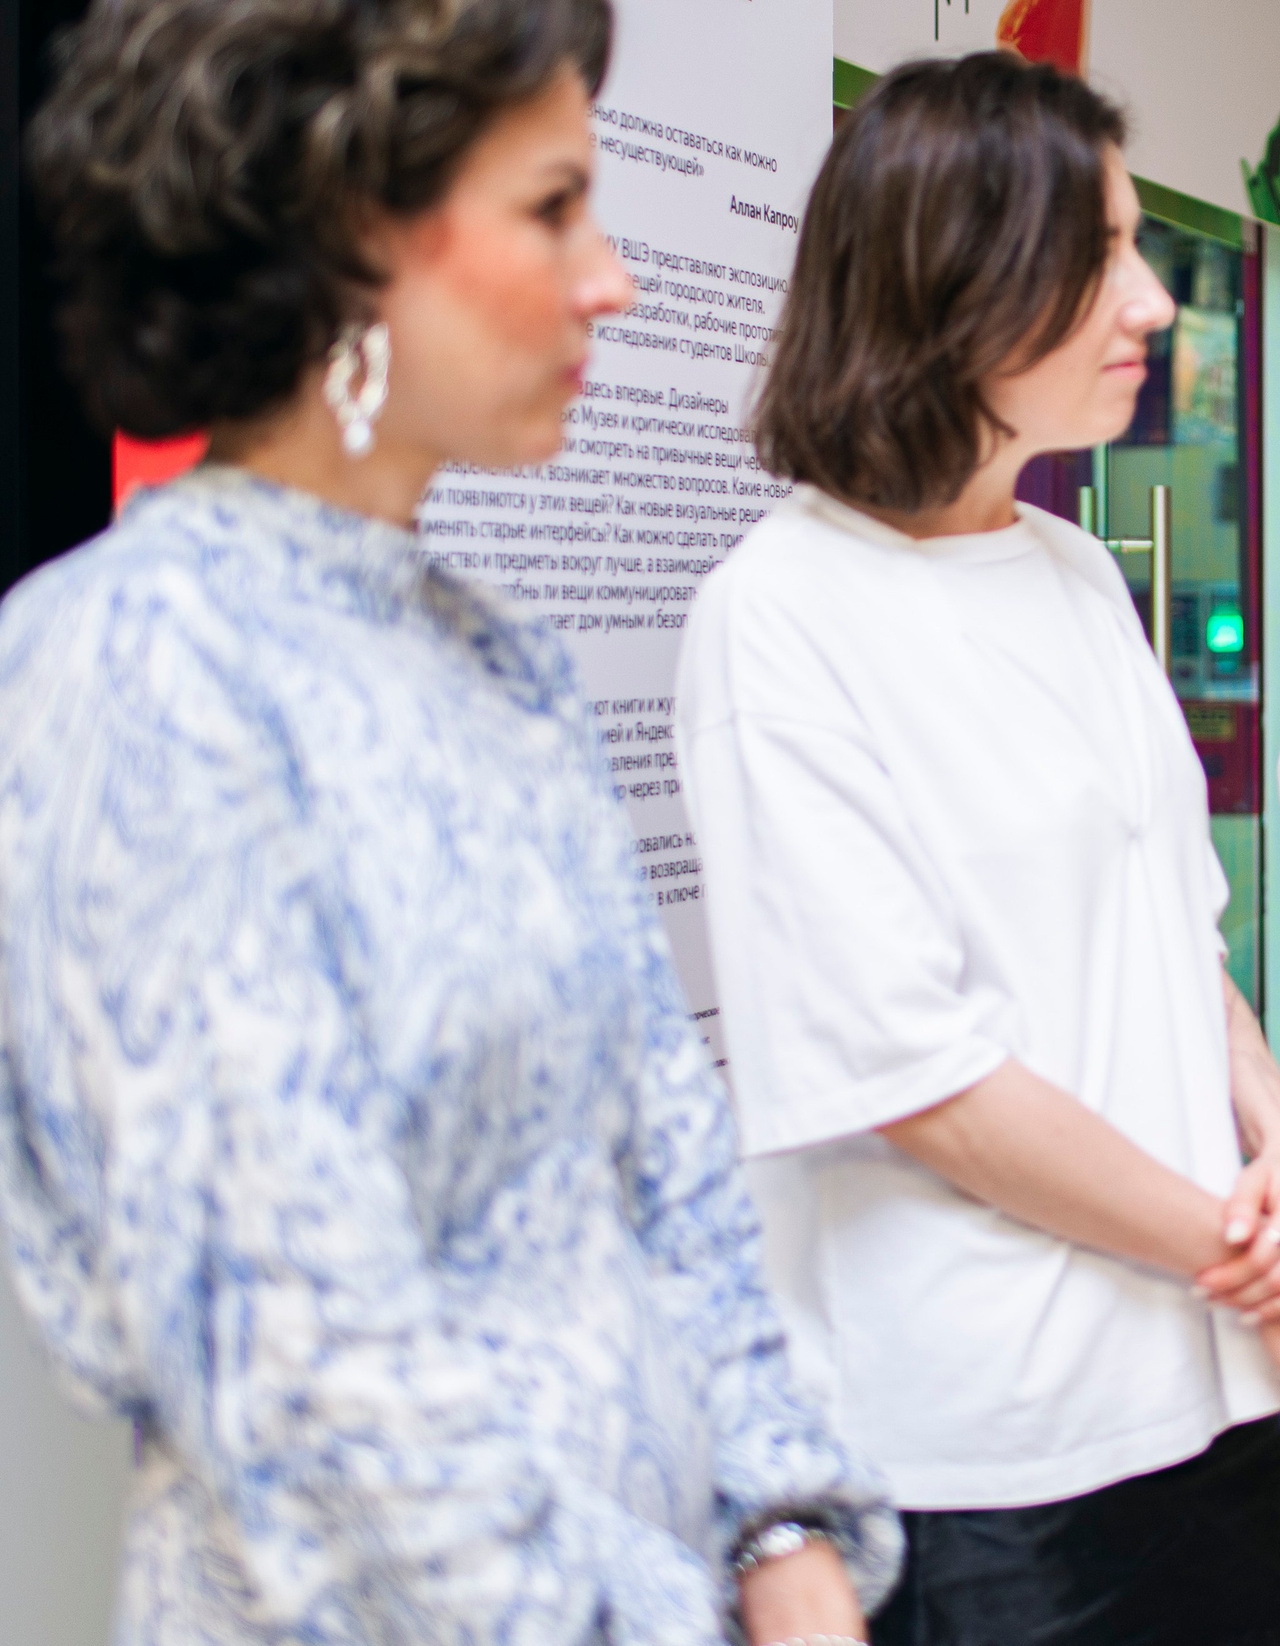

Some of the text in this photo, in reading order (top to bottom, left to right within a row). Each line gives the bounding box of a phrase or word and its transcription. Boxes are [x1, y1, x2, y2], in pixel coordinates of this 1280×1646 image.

[600, 134, 704, 177] несуществующей»
[619, 111, 663, 138] должна
[666, 125, 723, 154] оставаться
[725, 143, 741, 162] как
[743, 149, 777, 172] можно
[730, 195, 799, 234] Аллан Капроу
[622, 237, 649, 263] ВШЭ
[652, 249, 726, 281] представляют
[664, 281, 724, 306] городского
[726, 294, 765, 314] жителя.
[694, 312, 737, 335] рабочие
[597, 324, 677, 351] исследования
[680, 338, 731, 361] студентов
[615, 384, 664, 405] впервые.
[669, 388, 729, 414] Дизайнеры
[581, 404, 619, 430] Музея
[621, 414, 629, 429] и
[631, 415, 695, 437] критически
[580, 438, 634, 460] смотреть
[637, 444, 649, 460] на
[652, 445, 712, 466] привычные
[715, 451, 742, 472] вещи
[548, 464, 610, 487] возникает
[613, 471, 676, 491] множество
[678, 474, 730, 494] вопросов.
[732, 476, 762, 498] Какие
[764, 482, 793, 500] новые
[448, 488, 528, 510] появляются
[529, 494, 538, 514] у
[540, 495, 567, 511] этих
[570, 493, 614, 515] вещей?
[617, 496, 637, 516] Как
[640, 502, 673, 518] новые
[676, 503, 737, 523] визуальные
[481, 520, 527, 543] старые
[530, 521, 612, 545] интерфейсы?
[614, 525, 635, 544] Как
[637, 529, 675, 546] можно
[677, 530, 718, 549] сделать
[483, 552, 492, 569] и
[495, 552, 558, 573] предметы
[562, 556, 602, 576] вокруг
[605, 556, 645, 576] лучше,
[647, 558, 654, 573] а
[544, 584, 559, 600] ли
[562, 584, 594, 604] вещи
[578, 614, 603, 633] дом
[606, 614, 645, 634] умным
[647, 614, 654, 629] и
[612, 698, 645, 715] книги
[647, 697, 655, 713] и
[626, 727, 634, 742] и
[629, 780, 661, 802] через
[666, 884, 700, 905] ключе
